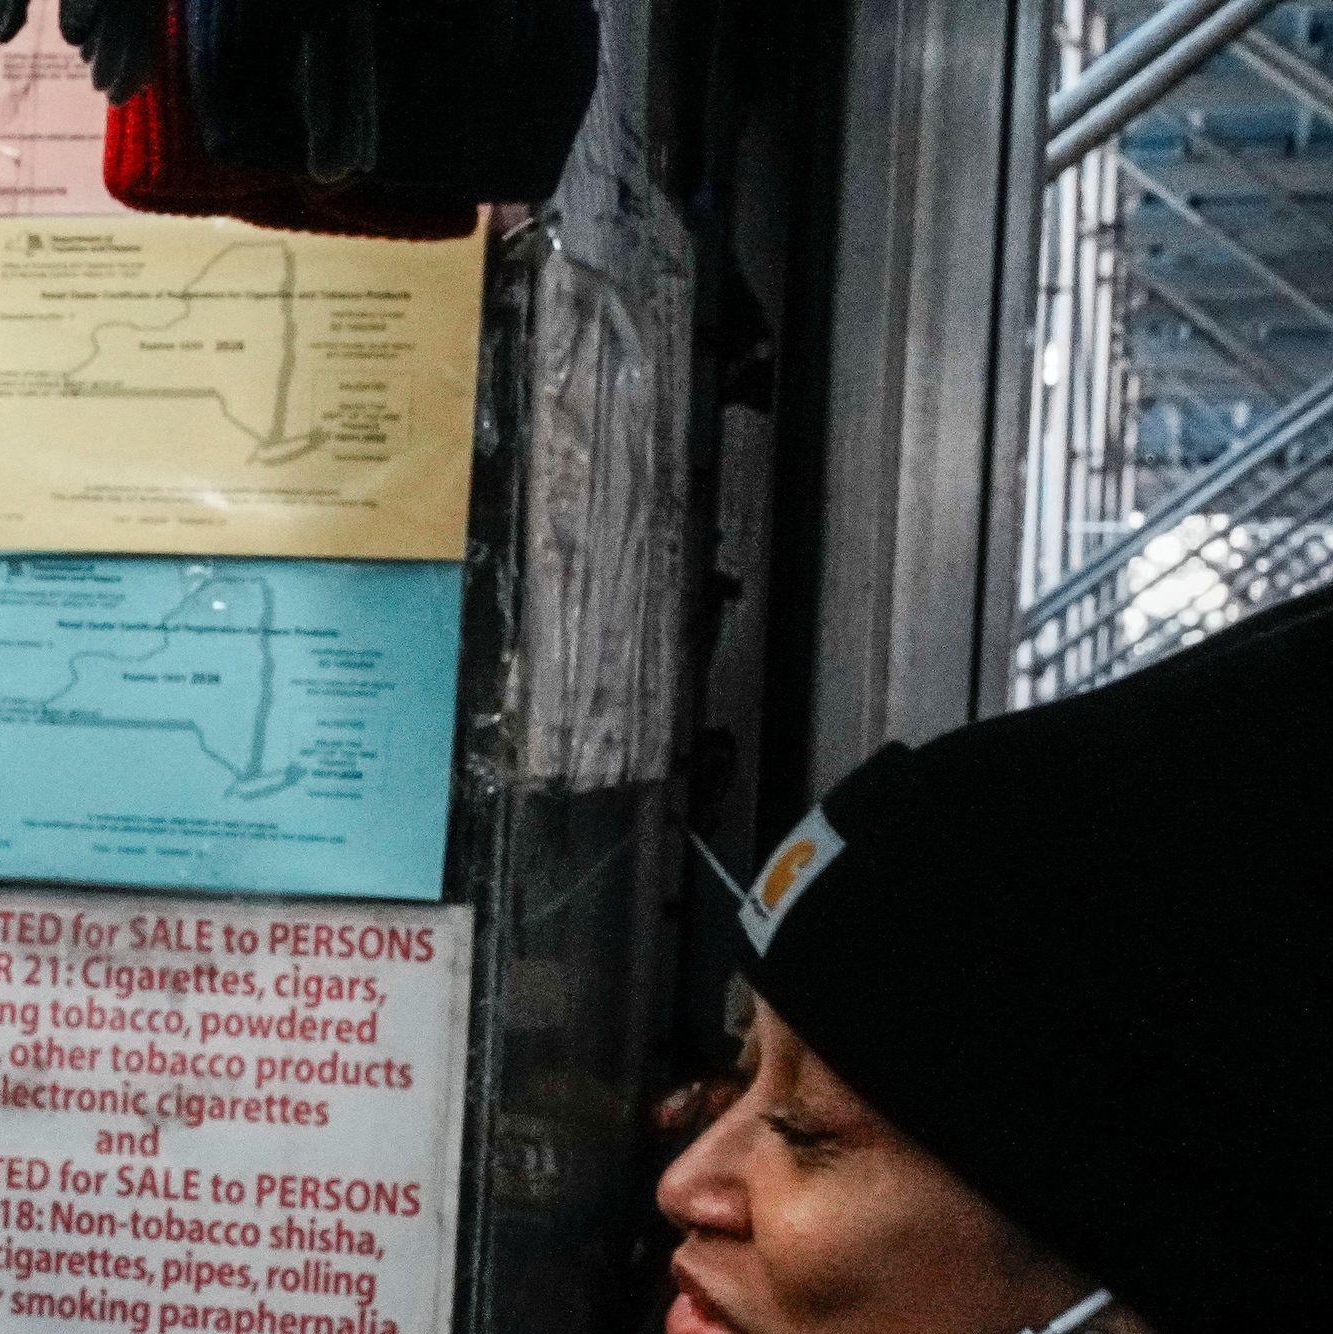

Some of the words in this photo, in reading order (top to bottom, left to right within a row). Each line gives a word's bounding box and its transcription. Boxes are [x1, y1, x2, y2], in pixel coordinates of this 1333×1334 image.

[71, 913, 120, 949] for
[128, 917, 213, 955] SALE
[223, 923, 259, 956] to
[269, 925, 435, 963] PERSONS
[24, 956, 75, 987] 21:
[81, 960, 265, 1005] Cigarettes,
[275, 966, 387, 1008] cigars,
[50, 1000, 192, 1039] tobacco,
[200, 1007, 377, 1045] powdered
[10, 1041, 98, 1071] other
[110, 1045, 245, 1080] tobacco
[255, 1053, 414, 1091] products
[155, 1086, 329, 1130] cigarettes
[95, 1125, 161, 1158] and
[60, 1159, 104, 1193] for
[116, 1165, 200, 1201] SALE
[212, 1171, 245, 1202] to
[256, 1174, 422, 1216] PERSONS
[1, 1199, 44, 1232] 18:
[50, 1200, 262, 1248] Non-tobacco
[268, 1210, 385, 1261] shisha,
[161, 1251, 261, 1292] pipes,
[266, 1261, 377, 1305] rolling
[10, 1289, 151, 1334] smoking
